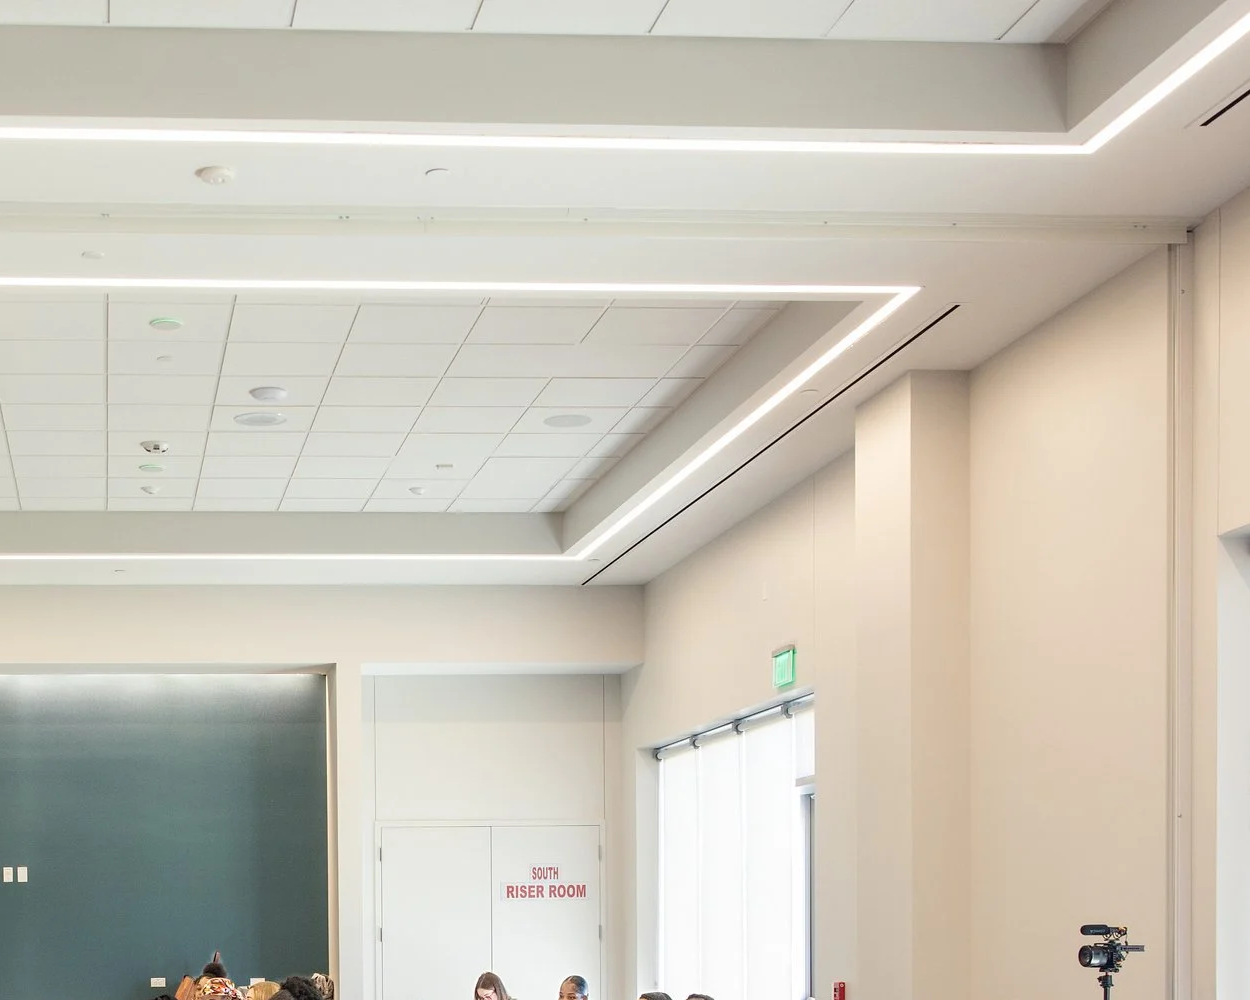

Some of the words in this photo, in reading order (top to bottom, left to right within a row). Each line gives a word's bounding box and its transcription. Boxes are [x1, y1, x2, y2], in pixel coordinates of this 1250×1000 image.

[532, 866, 559, 880] SOUTH
[506, 885, 544, 898] RISER
[549, 884, 587, 898] ROOM
